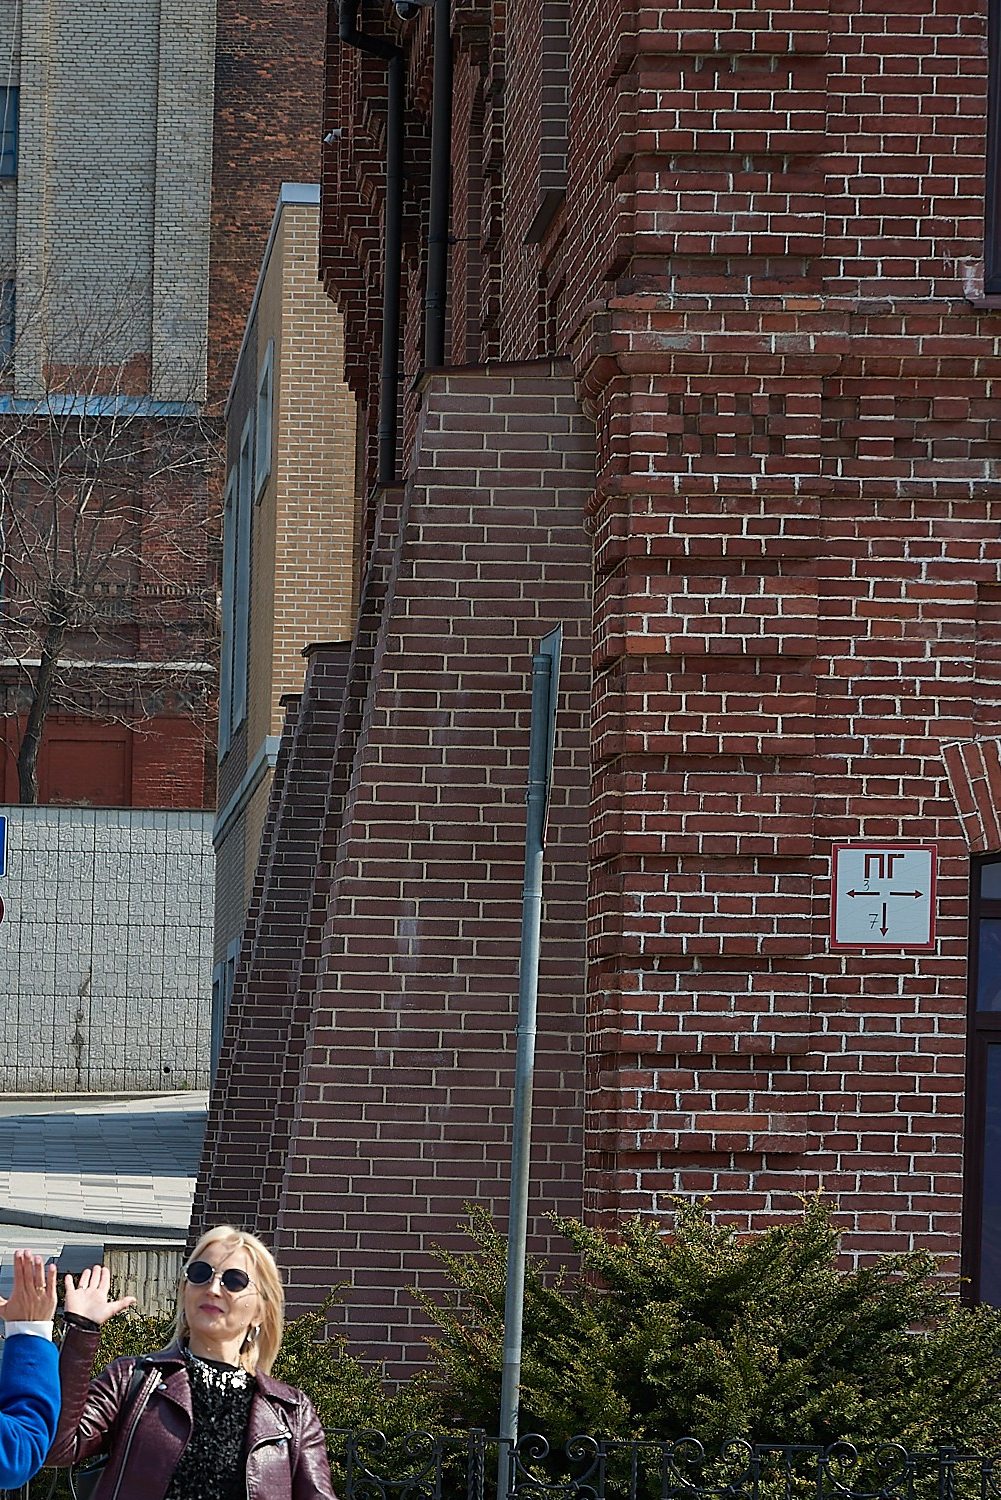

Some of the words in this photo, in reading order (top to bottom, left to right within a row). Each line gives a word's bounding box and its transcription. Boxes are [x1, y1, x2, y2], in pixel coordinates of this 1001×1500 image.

[864, 853, 904, 878] ПГ
[863, 880, 870, 891] 3
[868, 914, 879, 929] 7
